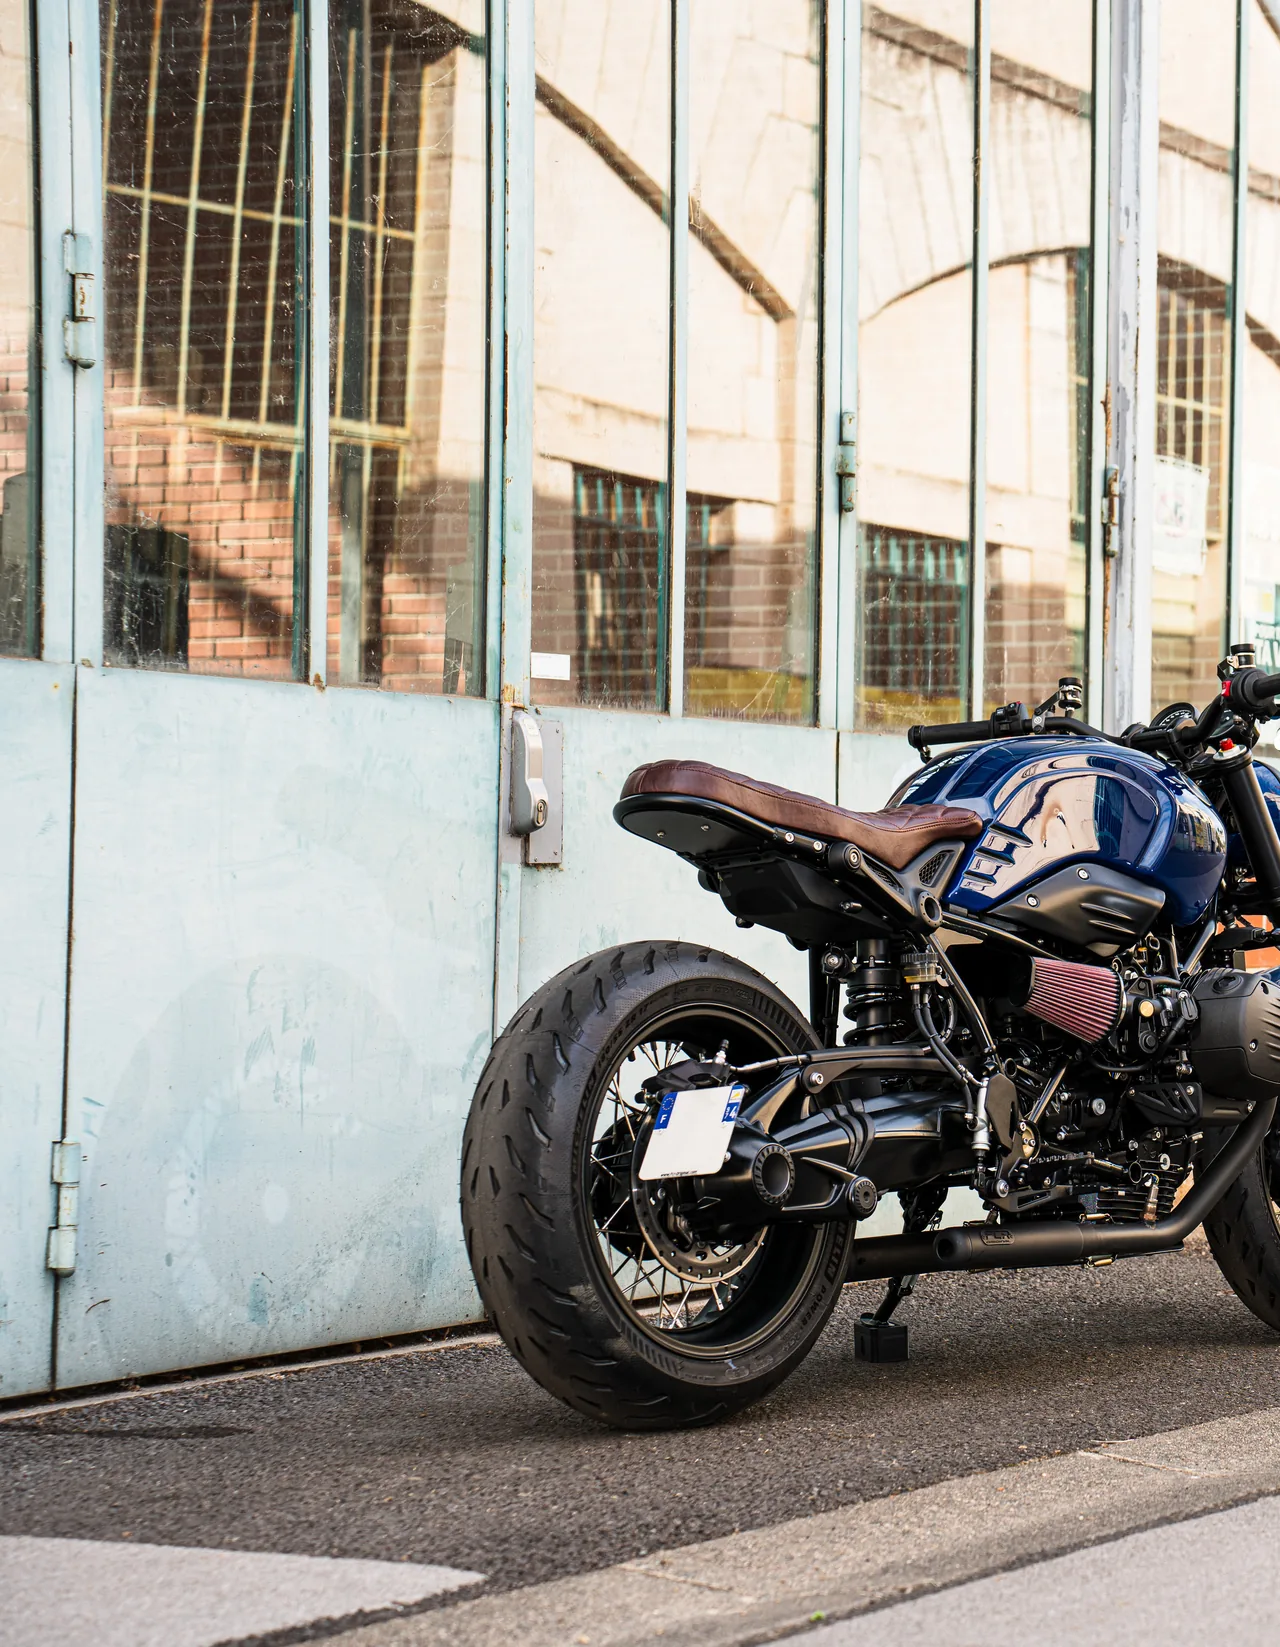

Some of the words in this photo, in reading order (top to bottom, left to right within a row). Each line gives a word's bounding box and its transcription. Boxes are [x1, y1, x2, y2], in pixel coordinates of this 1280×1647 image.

[1255, 639, 1273, 667] TA
[660, 1114, 667, 1123] F
[801, 1284, 827, 1326] POWER
